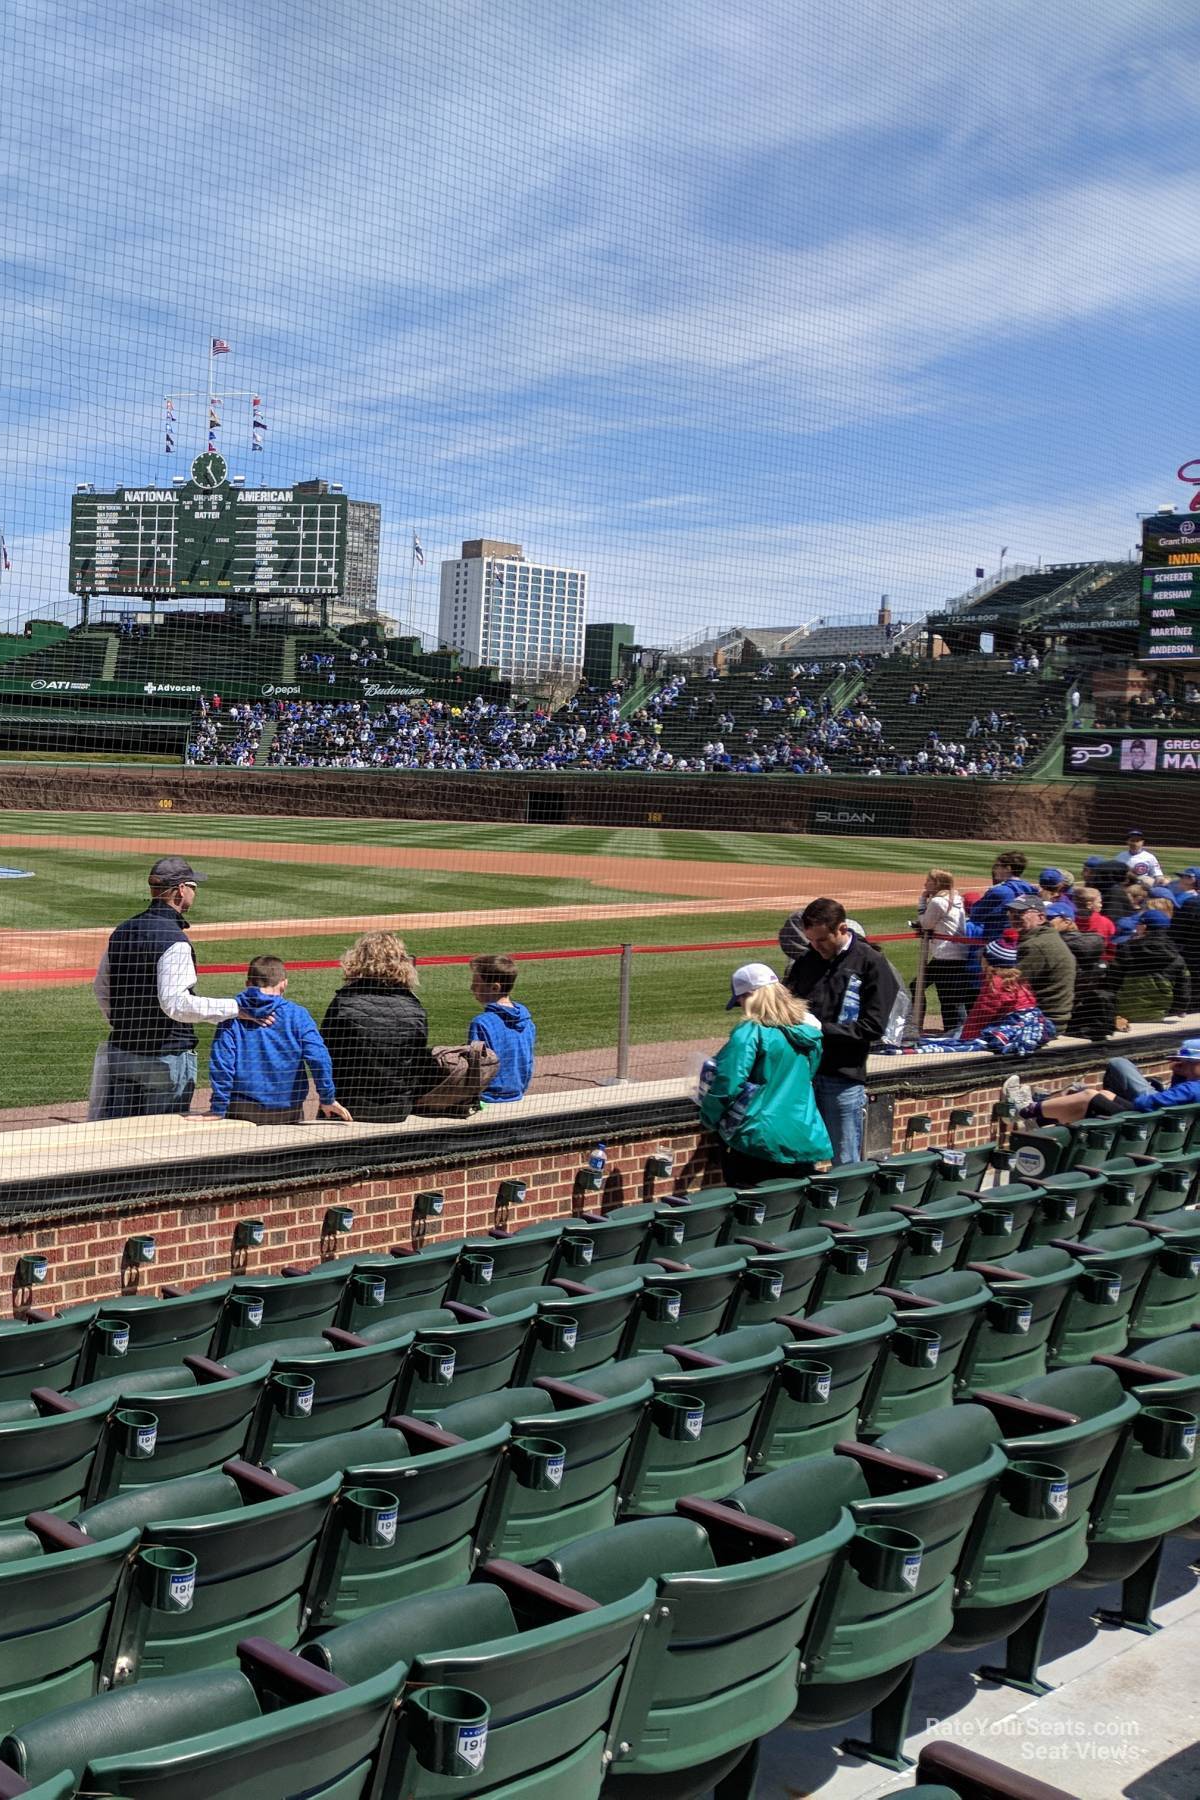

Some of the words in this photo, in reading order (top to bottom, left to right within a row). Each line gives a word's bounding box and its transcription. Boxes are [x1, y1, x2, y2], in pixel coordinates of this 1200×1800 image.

[124, 490, 180, 503] NATIONAL
[236, 490, 294, 503] AMERICAN
[194, 511, 221, 520] BATTER
[1158, 537, 1180, 547] Grant
[1154, 572, 1194, 583] SCHERZER
[1153, 590, 1193, 600] KERSHAW
[1151, 608, 1176, 619] NOVA
[1150, 625, 1193, 637] MARTÍNEZ
[1149, 645, 1194, 655] ANDERSON
[46, 681, 71, 690] ATI
[157, 684, 202, 692] Advocate
[274, 686, 301, 695] pepsi
[362, 683, 427, 697] Budweiser
[1163, 739, 1200, 750] GREG
[1162, 753, 1200, 769] MA
[815, 811, 876, 823] SLOAN
